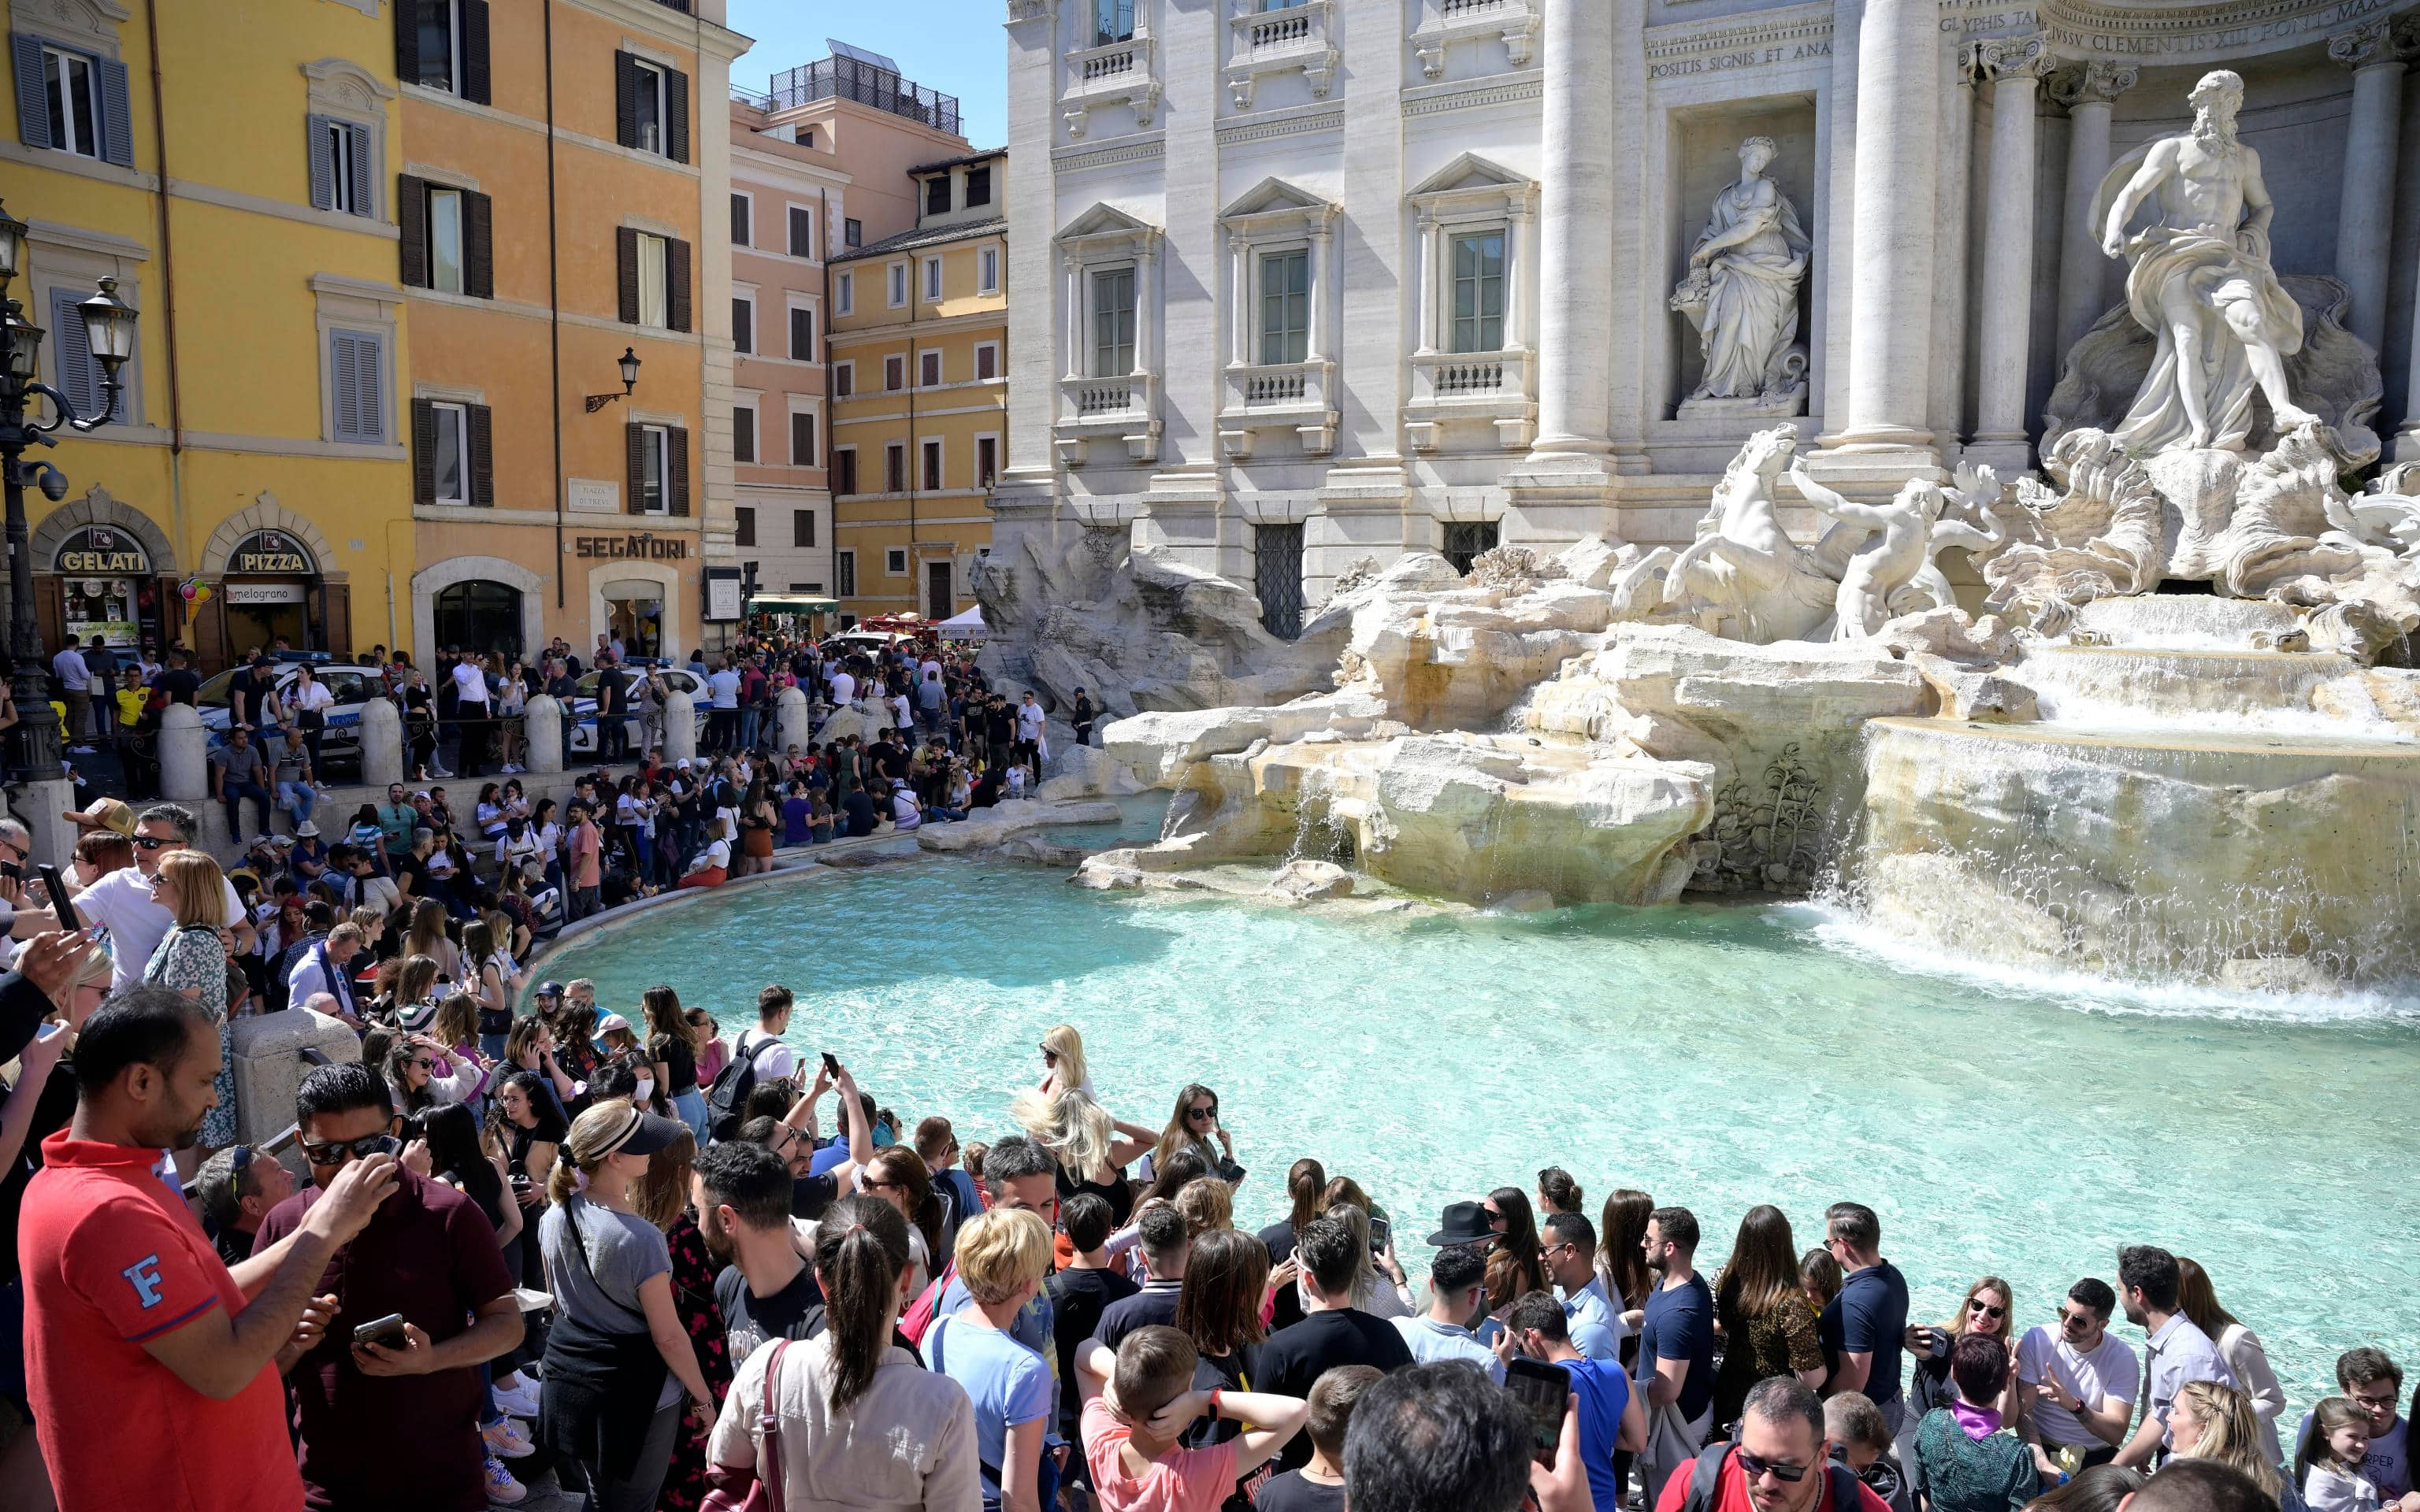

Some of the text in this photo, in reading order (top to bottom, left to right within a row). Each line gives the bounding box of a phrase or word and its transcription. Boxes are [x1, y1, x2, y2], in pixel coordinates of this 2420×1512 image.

[2092, 34, 2206, 54] CLEMENTIS
[2262, 12, 2321, 40] PONT
[1650, 41, 1832, 77] POSITIS SIGNIS ET ANA
[582, 486, 606, 495] PIAZZA
[577, 535, 686, 559] SEGATORI
[61, 552, 145, 570] GELATI
[241, 554, 304, 570] PIZZA
[235, 588, 288, 602] melograno
[122, 1254, 163, 1310] F
[2366, 1454, 2394, 1468] RPER
